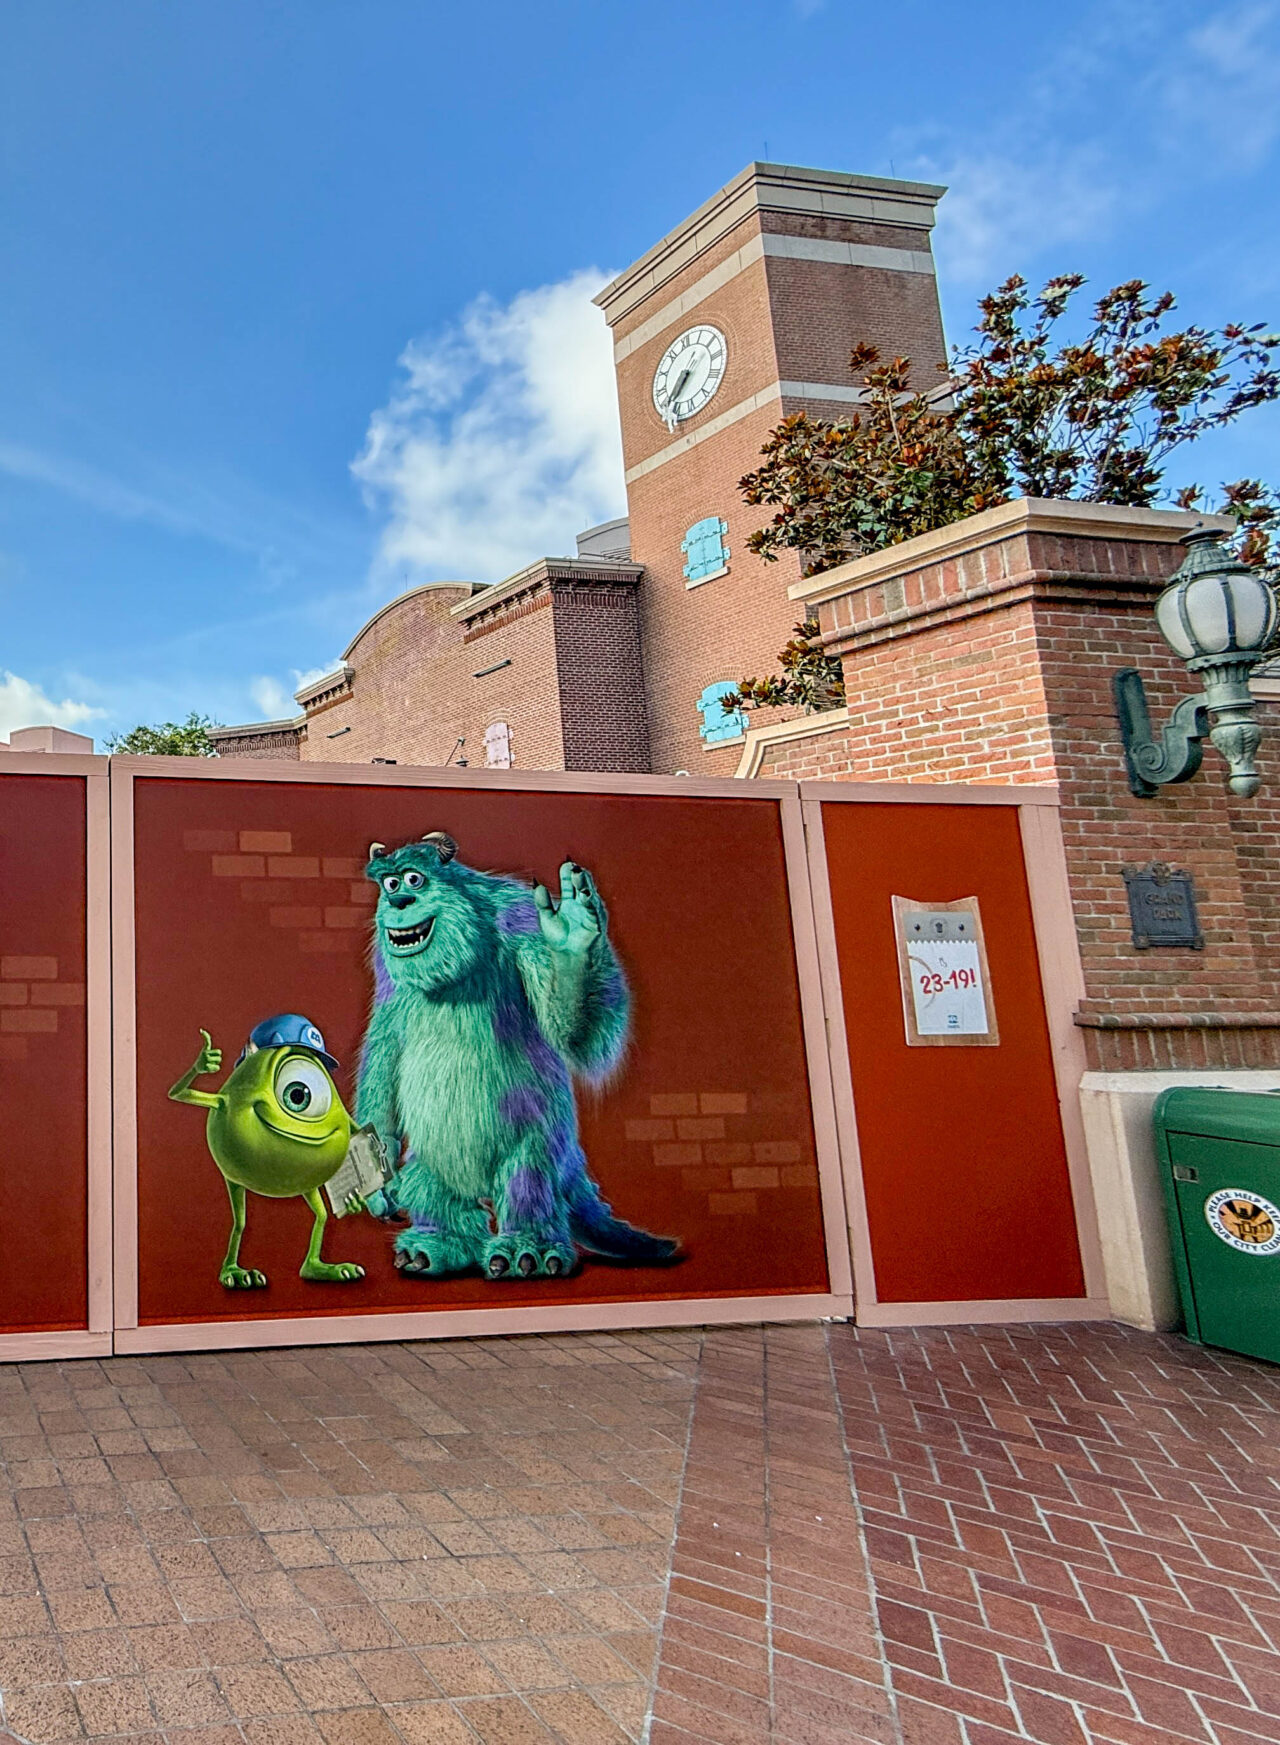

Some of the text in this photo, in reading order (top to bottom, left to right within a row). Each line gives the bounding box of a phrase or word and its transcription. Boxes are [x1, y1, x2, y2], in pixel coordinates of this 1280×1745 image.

[920, 968, 977, 994] 23-19!
[1208, 1192, 1231, 1213] PLEASE
[1234, 1192, 1261, 1202] HELP
[1213, 1222, 1232, 1240] OUR
[1233, 1239, 1258, 1251] CITY
